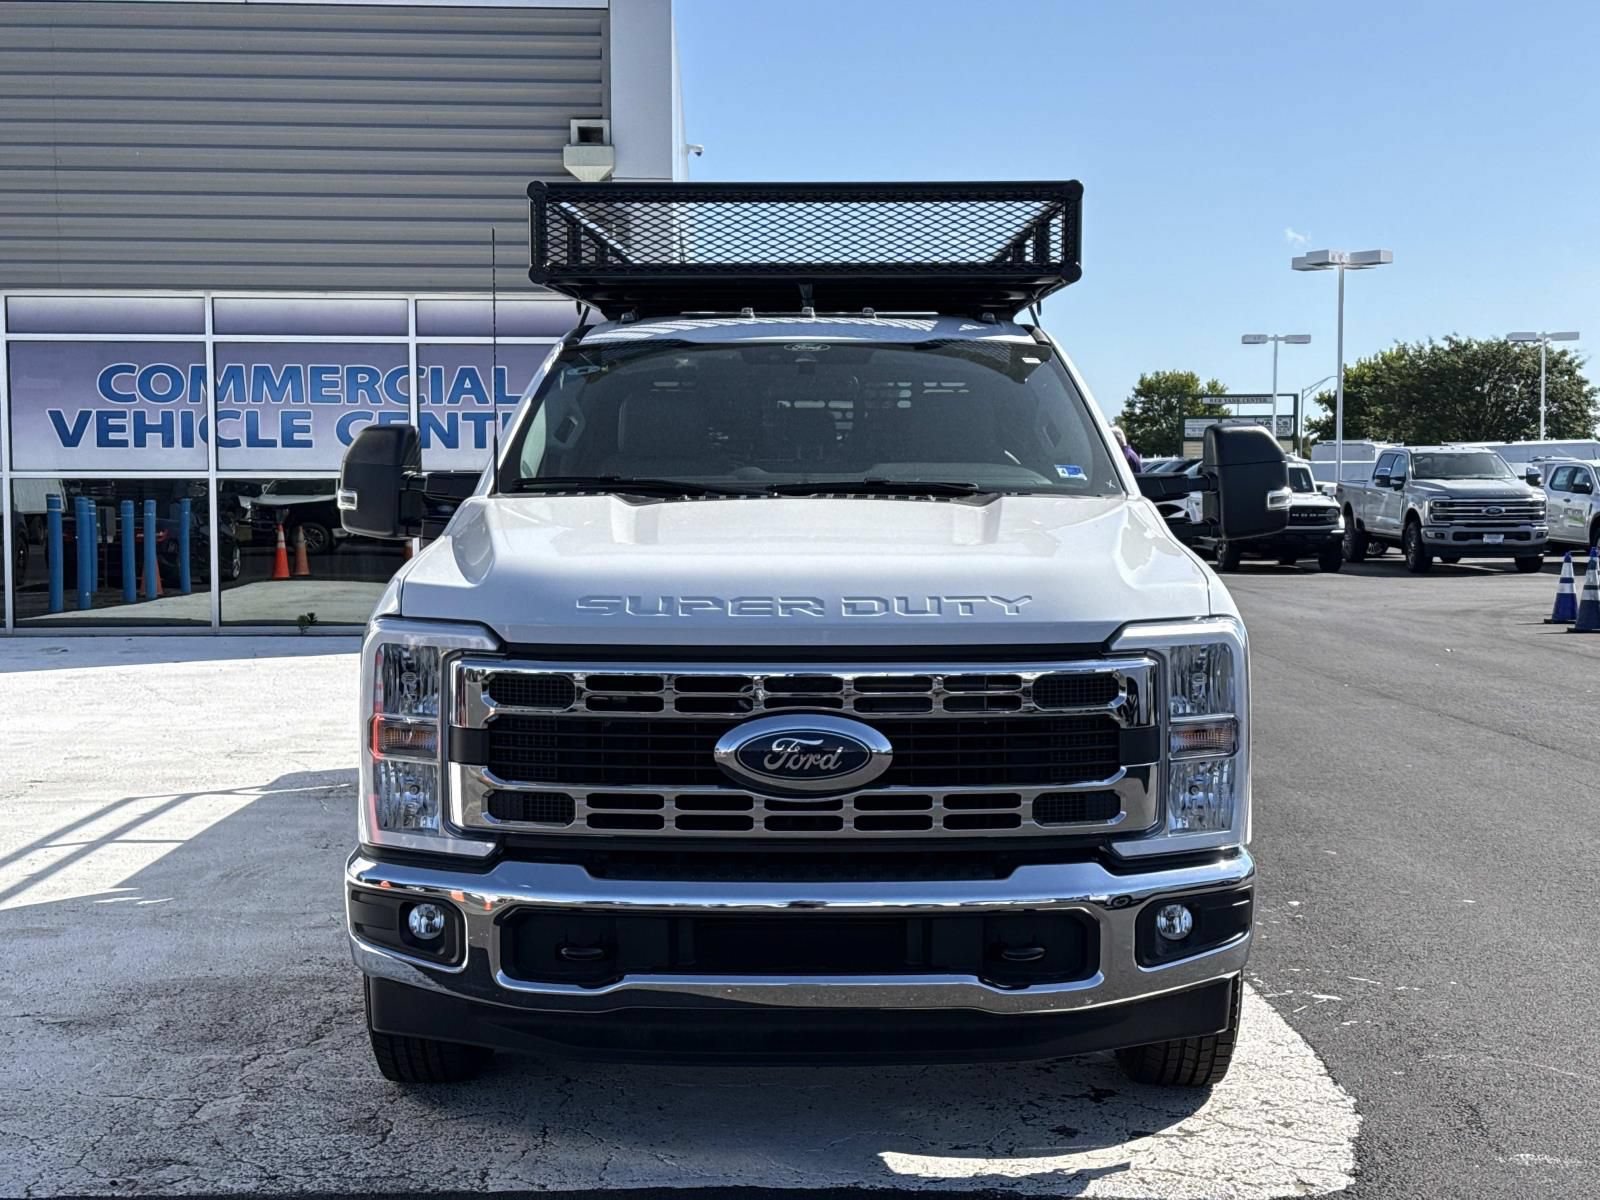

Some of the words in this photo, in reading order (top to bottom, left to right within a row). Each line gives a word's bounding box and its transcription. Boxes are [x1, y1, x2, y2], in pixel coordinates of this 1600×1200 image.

[97, 363, 524, 405] COMMERCIAL
[47, 409, 314, 449] VEHICLE
[575, 595, 825, 617] SUPER
[841, 595, 1033, 616] DUTY
[763, 737, 844, 770] Ford
